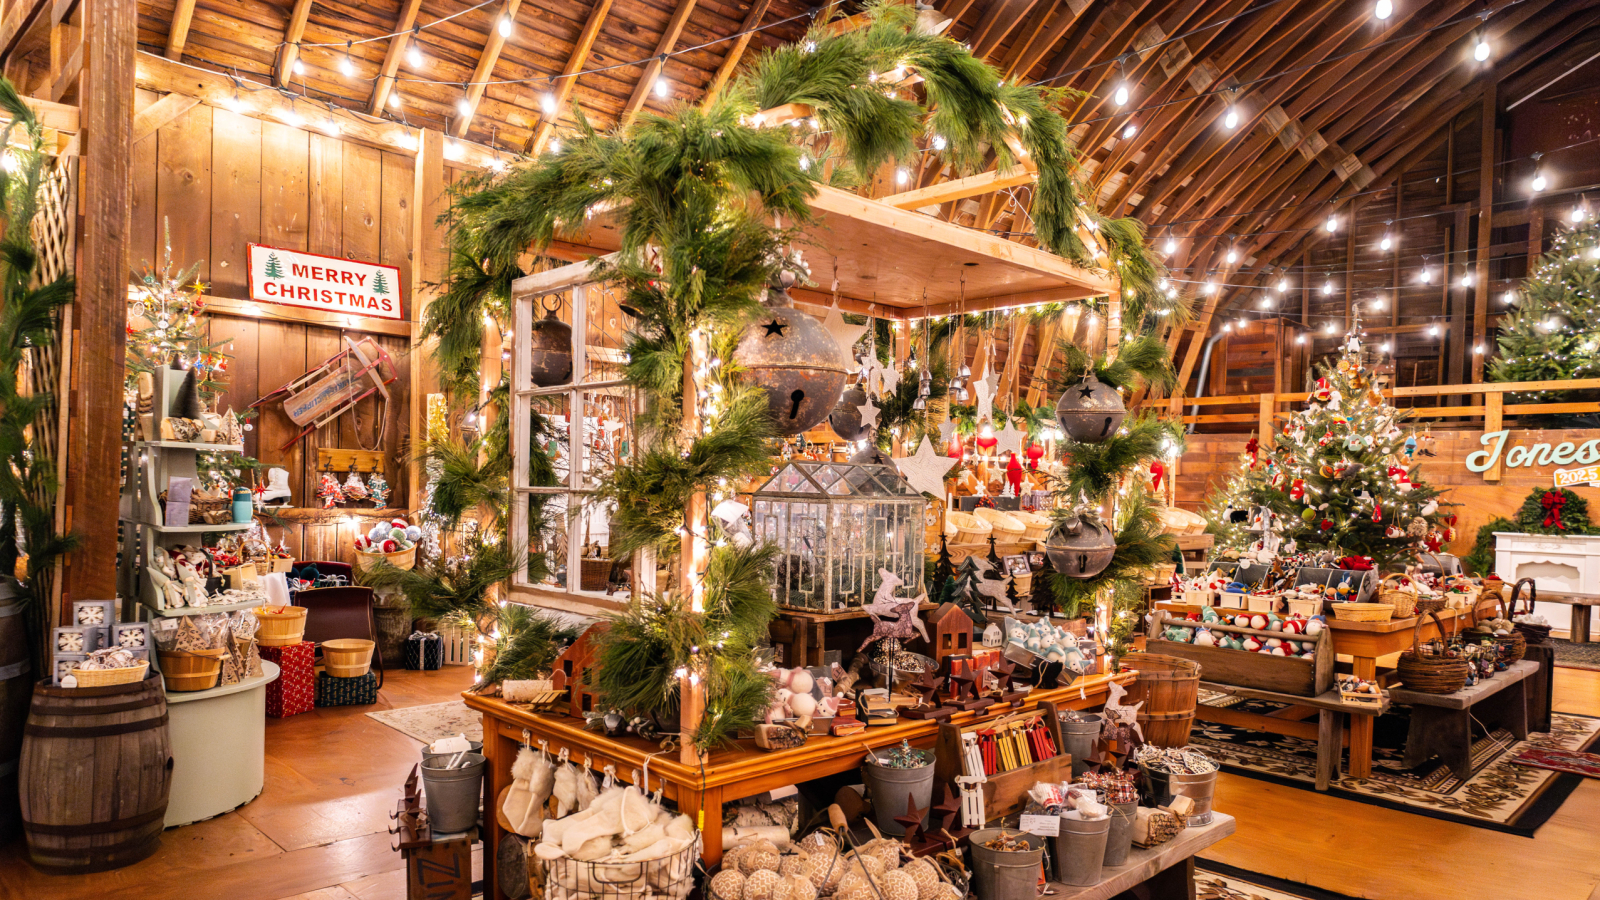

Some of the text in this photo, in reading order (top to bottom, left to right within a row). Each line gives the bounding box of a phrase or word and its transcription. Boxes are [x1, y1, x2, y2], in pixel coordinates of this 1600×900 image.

[292, 263, 367, 287] MERRY
[263, 281, 393, 312] CHRISTMAS
[1465, 429, 1600, 473] Jones
[1559, 468, 1598, 485] 2025
